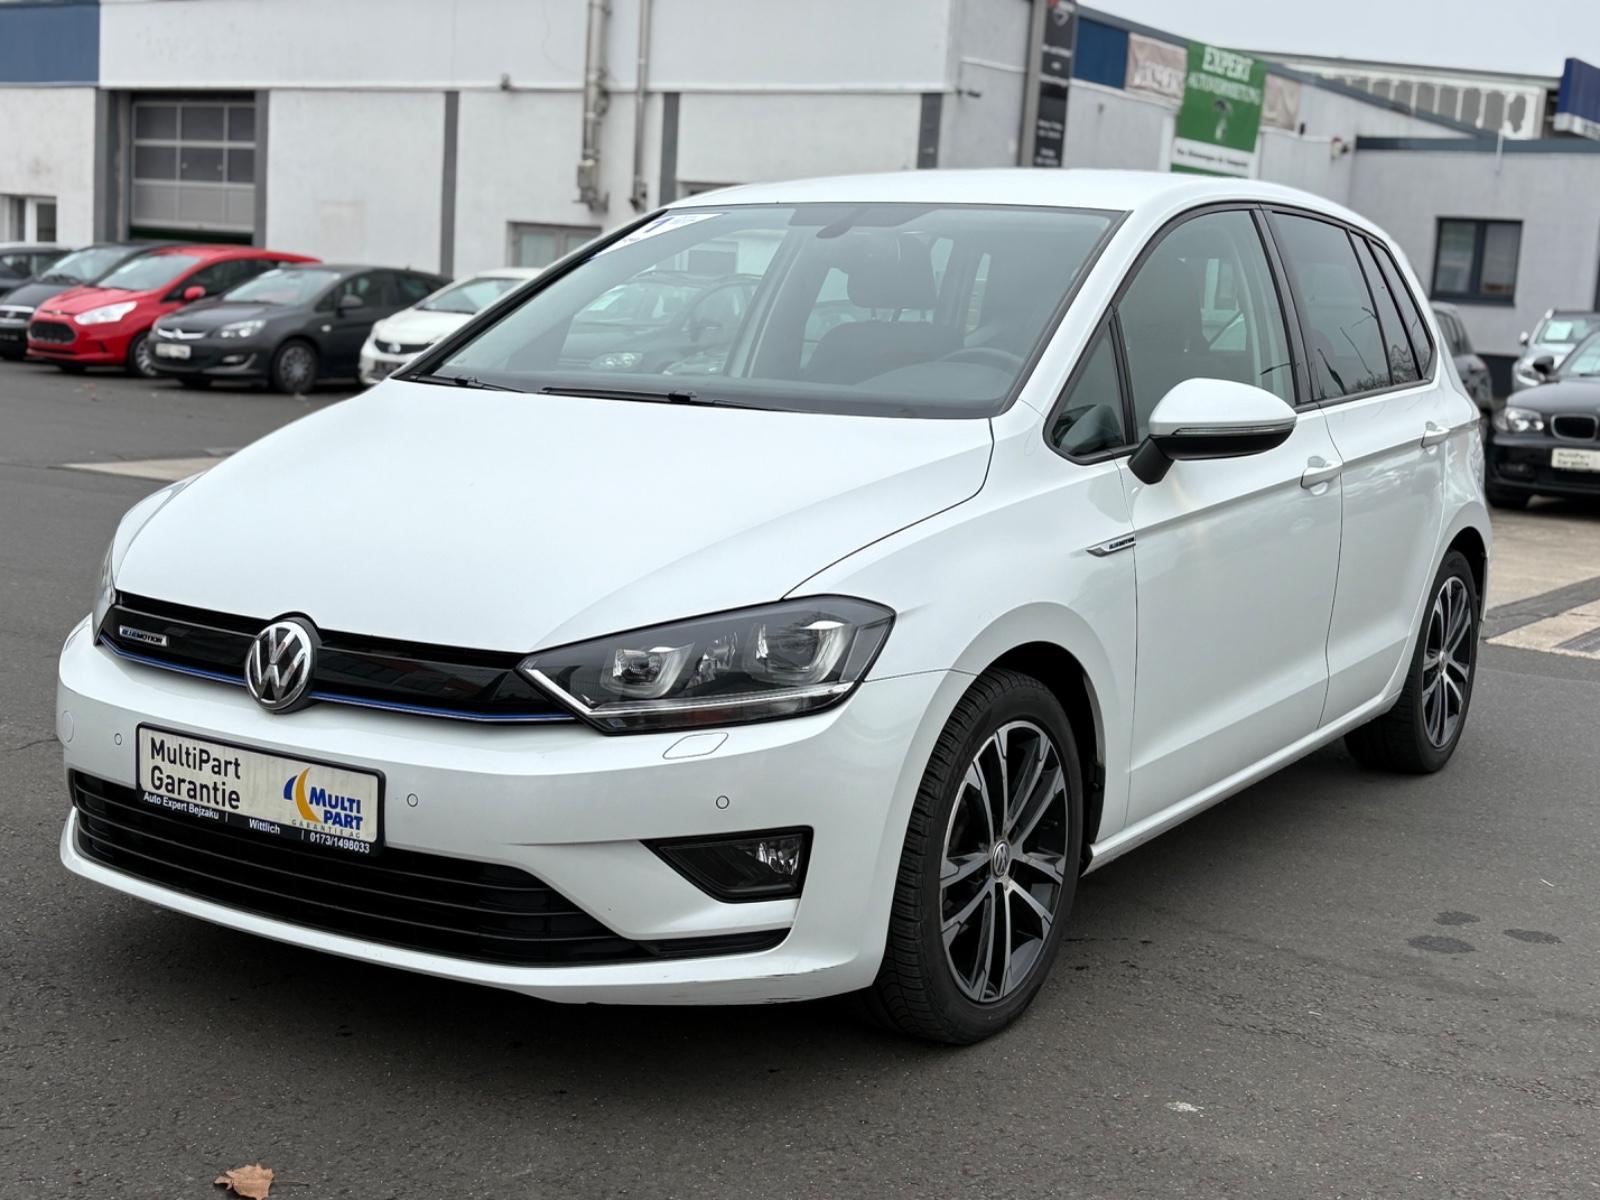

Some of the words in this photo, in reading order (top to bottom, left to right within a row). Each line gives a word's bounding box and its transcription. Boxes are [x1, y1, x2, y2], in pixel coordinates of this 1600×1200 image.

[150, 738, 240, 779] MultiPart
[150, 765, 240, 810] Garantie
[309, 786, 362, 814] MULTI
[143, 793, 162, 804] Auto
[163, 797, 188, 812] Expert
[249, 818, 280, 835] Wittlich
[309, 832, 370, 854] 0173/1498033
[323, 811, 363, 831] PART
